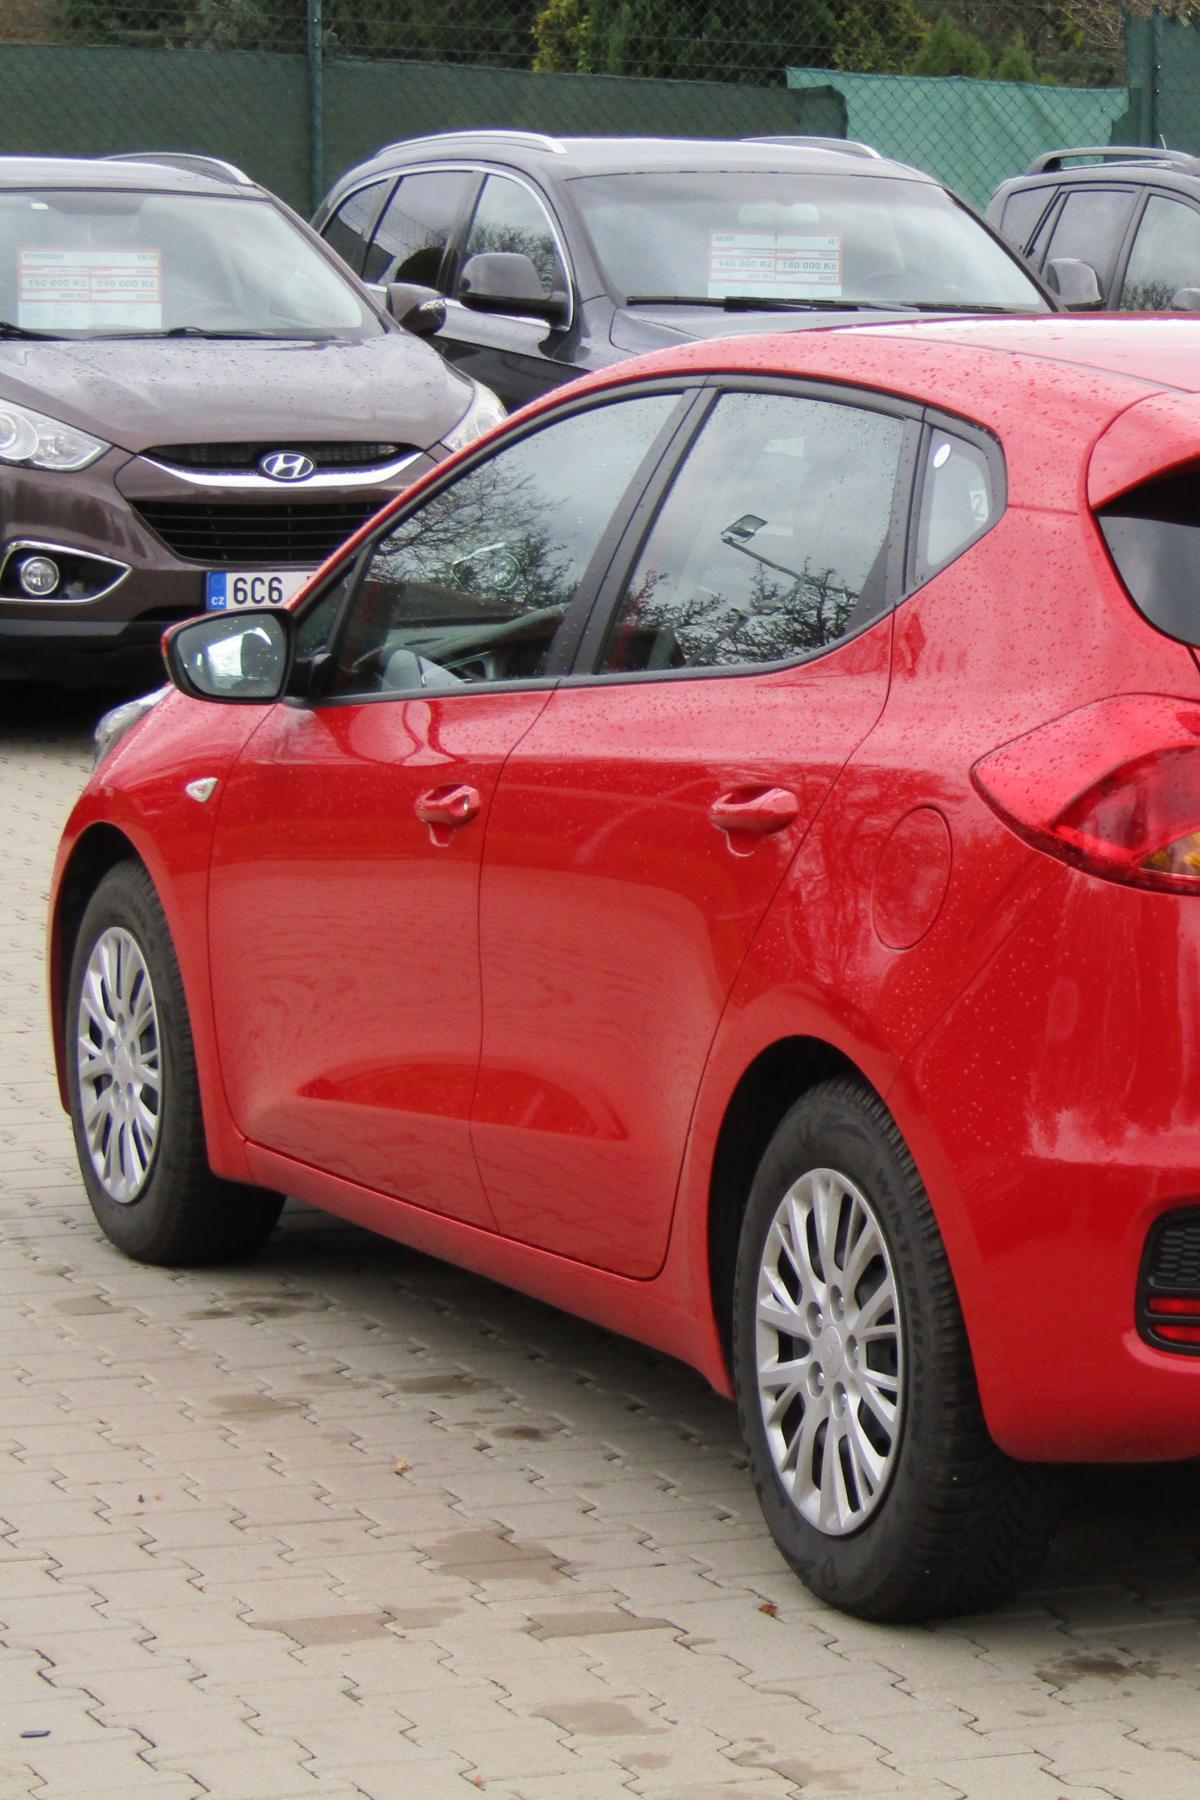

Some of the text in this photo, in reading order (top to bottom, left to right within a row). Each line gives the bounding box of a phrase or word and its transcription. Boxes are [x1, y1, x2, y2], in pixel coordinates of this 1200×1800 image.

[760, 260, 773, 269] Kč
[802, 262, 821, 271] 000
[823, 263, 837, 271] Kč
[50, 279, 70, 288] 000
[72, 278, 87, 288] Kč
[119, 279, 138, 288] 000
[141, 280, 156, 288] Kč
[233, 576, 283, 605] 6C6
[211, 595, 225, 606] CZ
